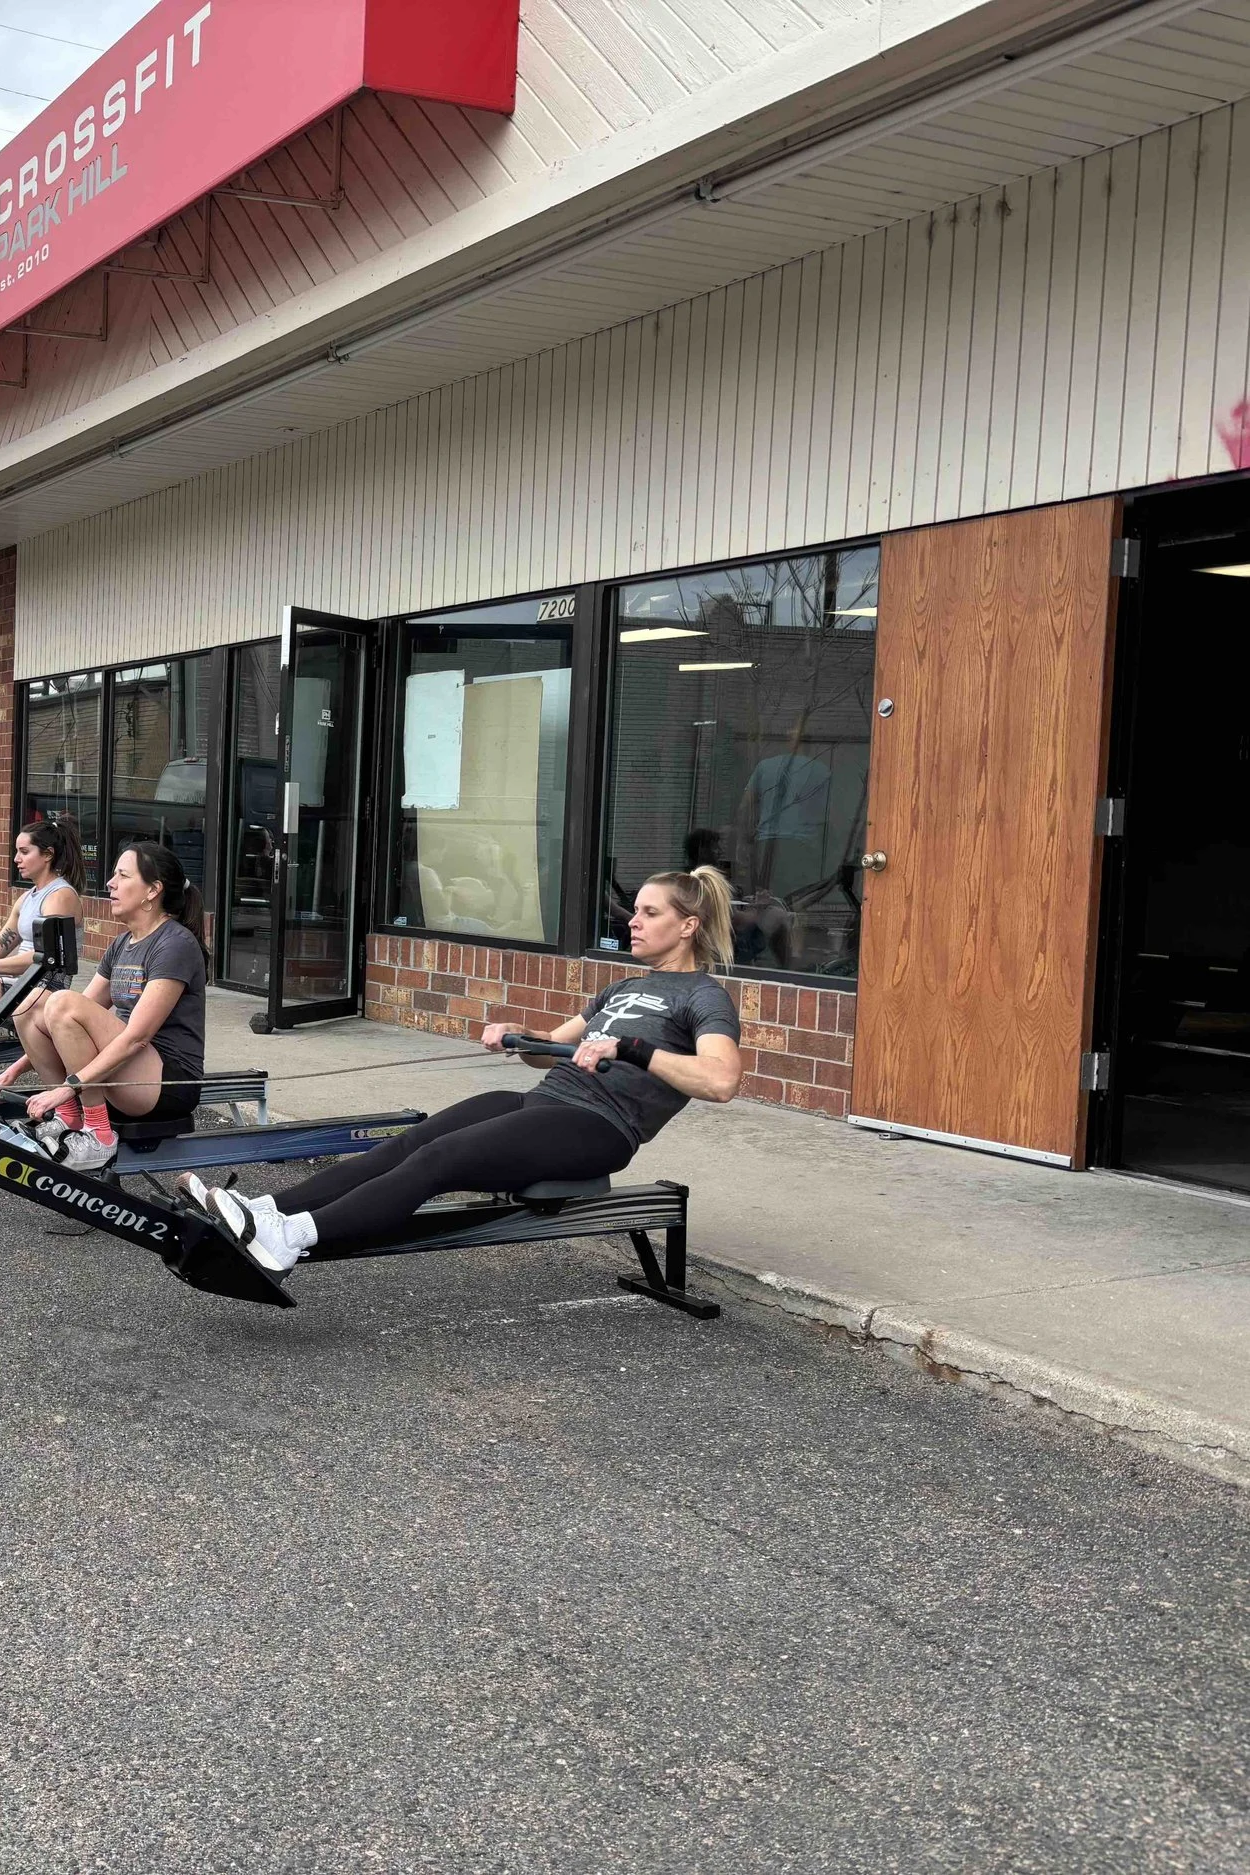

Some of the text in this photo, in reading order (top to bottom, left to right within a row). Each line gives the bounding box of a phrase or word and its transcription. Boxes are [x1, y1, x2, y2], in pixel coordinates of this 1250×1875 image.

[67, 142, 128, 217] HILL
[17, 243, 50, 279] 2010
[539, 597, 575, 620] 7200
[35, 1175, 168, 1240] concept 2
